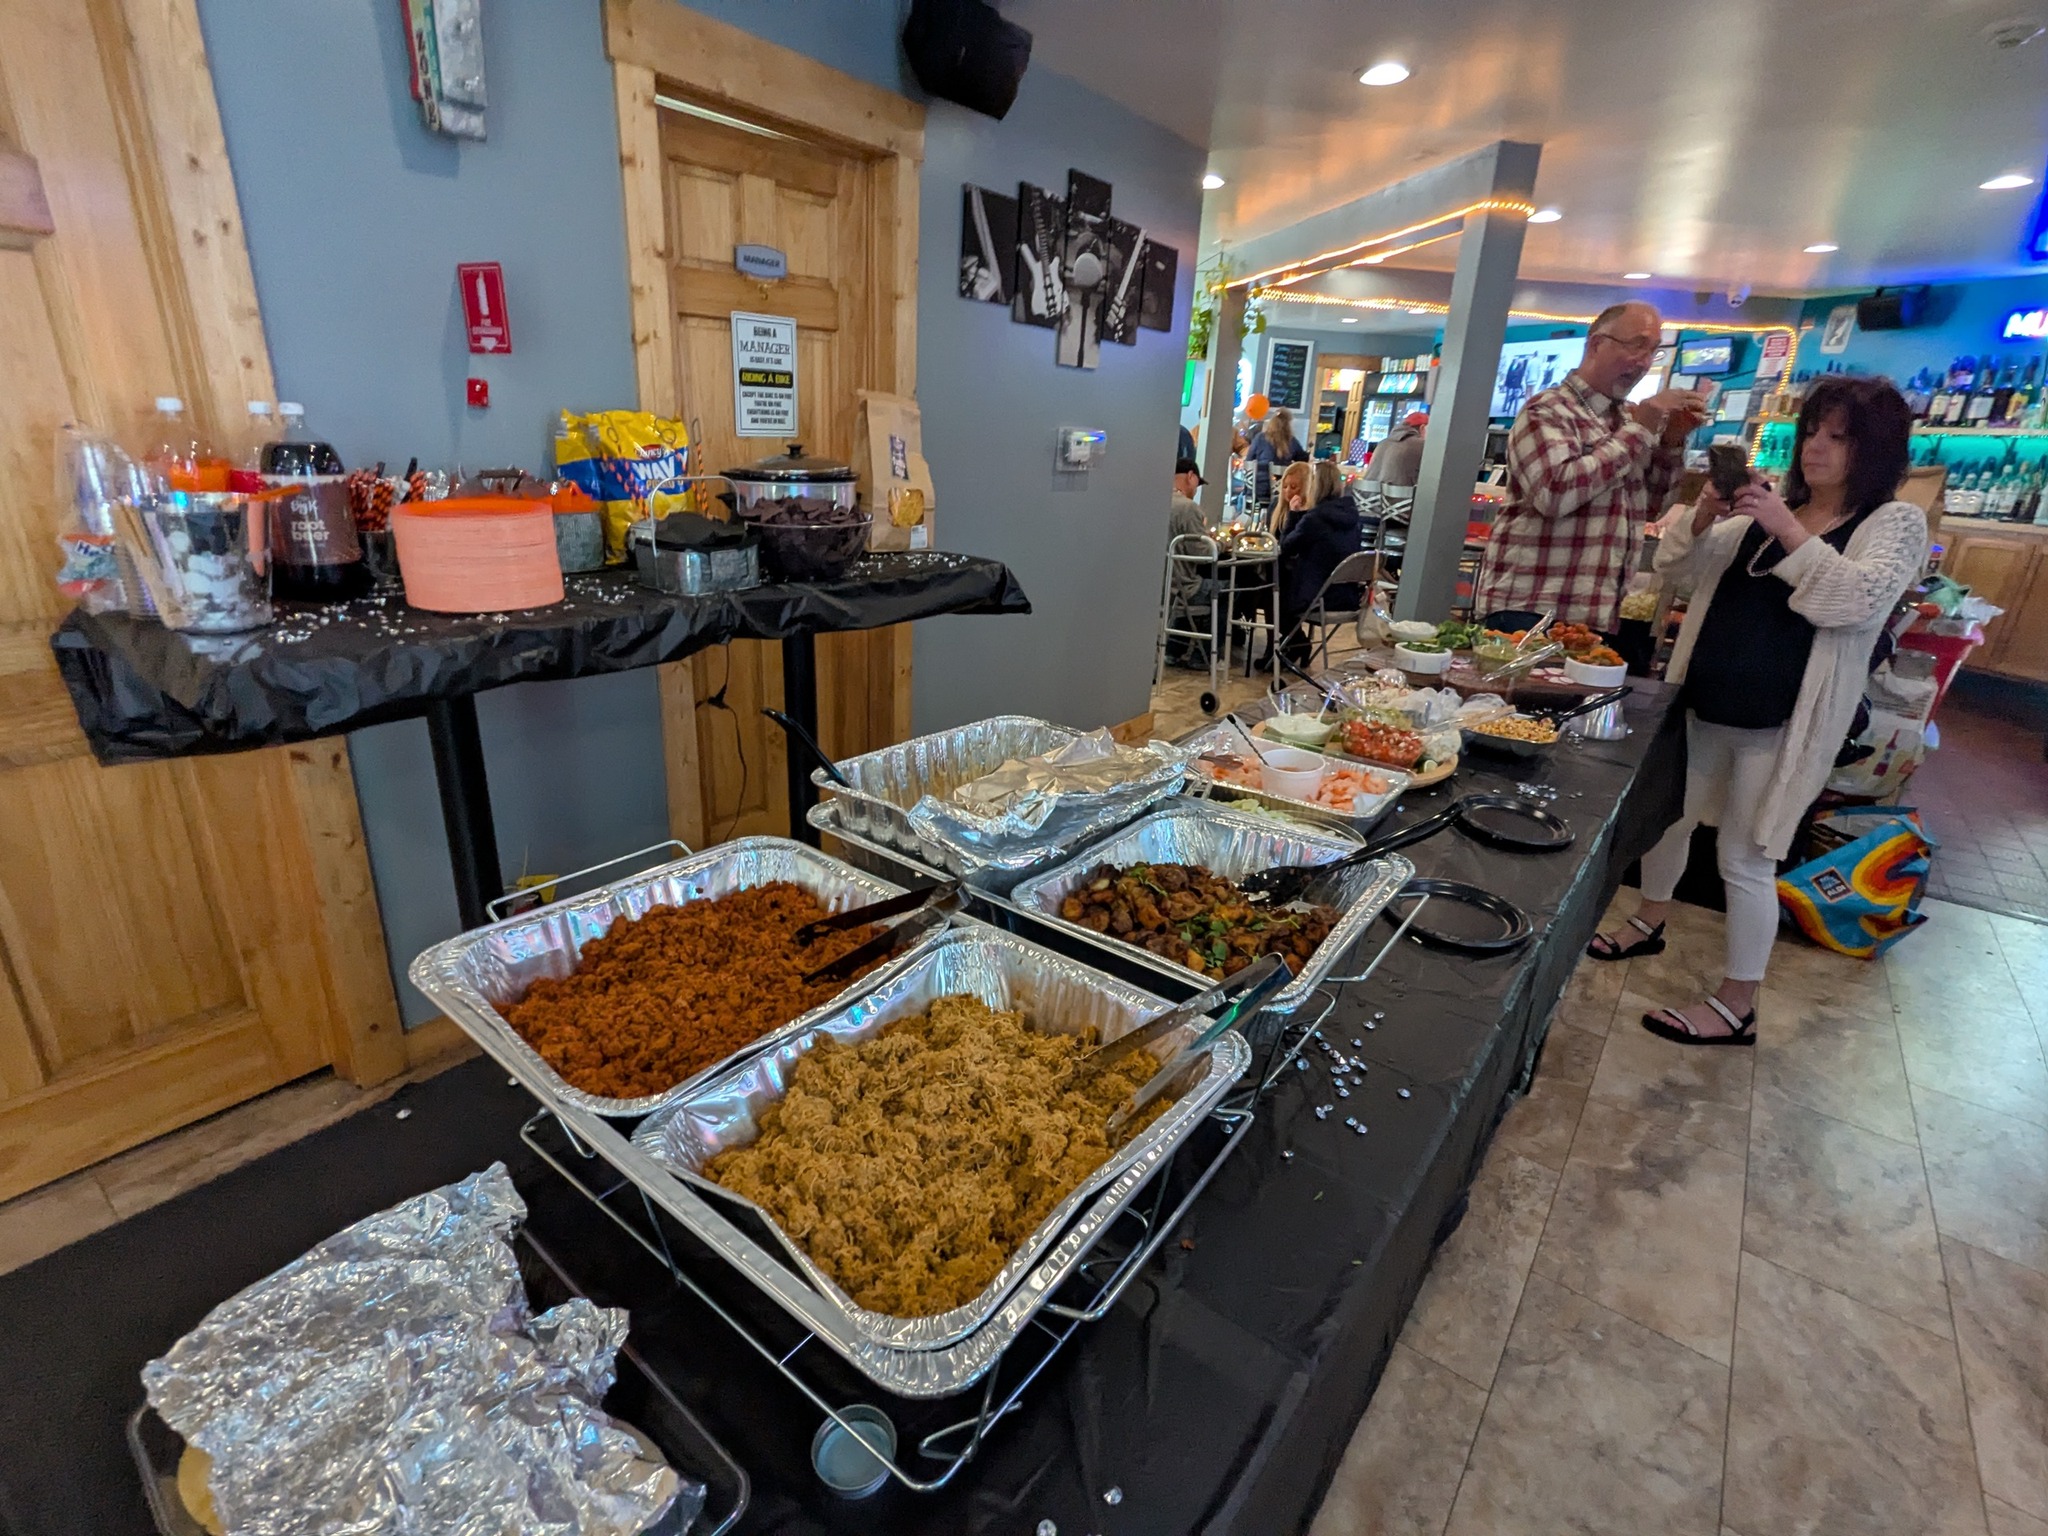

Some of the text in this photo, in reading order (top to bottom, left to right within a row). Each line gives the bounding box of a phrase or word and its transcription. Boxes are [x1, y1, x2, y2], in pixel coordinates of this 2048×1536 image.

[740, 340, 791, 355] MANAGER
[768, 373, 774, 384] A
[291, 520, 326, 531] root
[292, 531, 330, 542] beer
